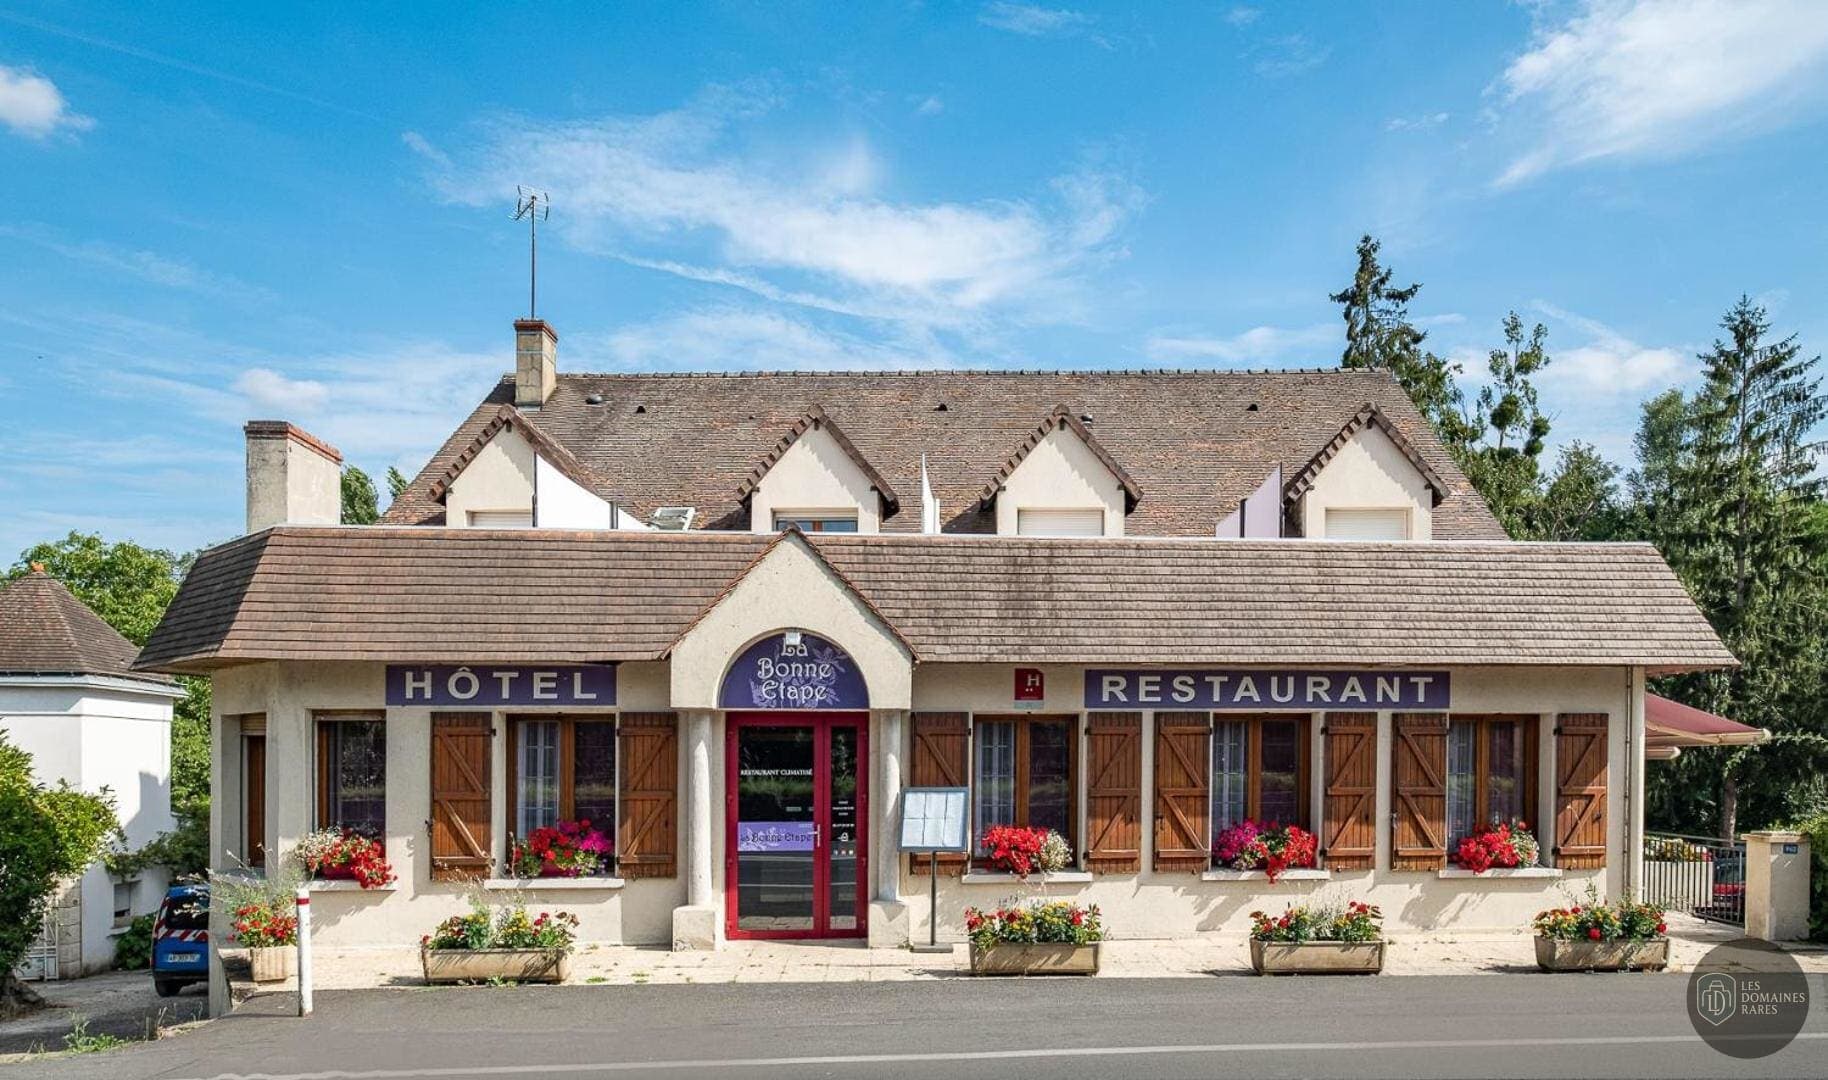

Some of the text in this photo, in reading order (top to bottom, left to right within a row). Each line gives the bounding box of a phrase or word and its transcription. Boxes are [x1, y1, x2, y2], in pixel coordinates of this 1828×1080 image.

[757, 657, 832, 680] Bonne
[404, 666, 597, 700] HÔTEL
[761, 680, 828, 703] Etape
[1027, 674, 1040, 687] H
[1101, 675, 1434, 703] RESTAURANT
[740, 768, 779, 776] RESTAURANT
